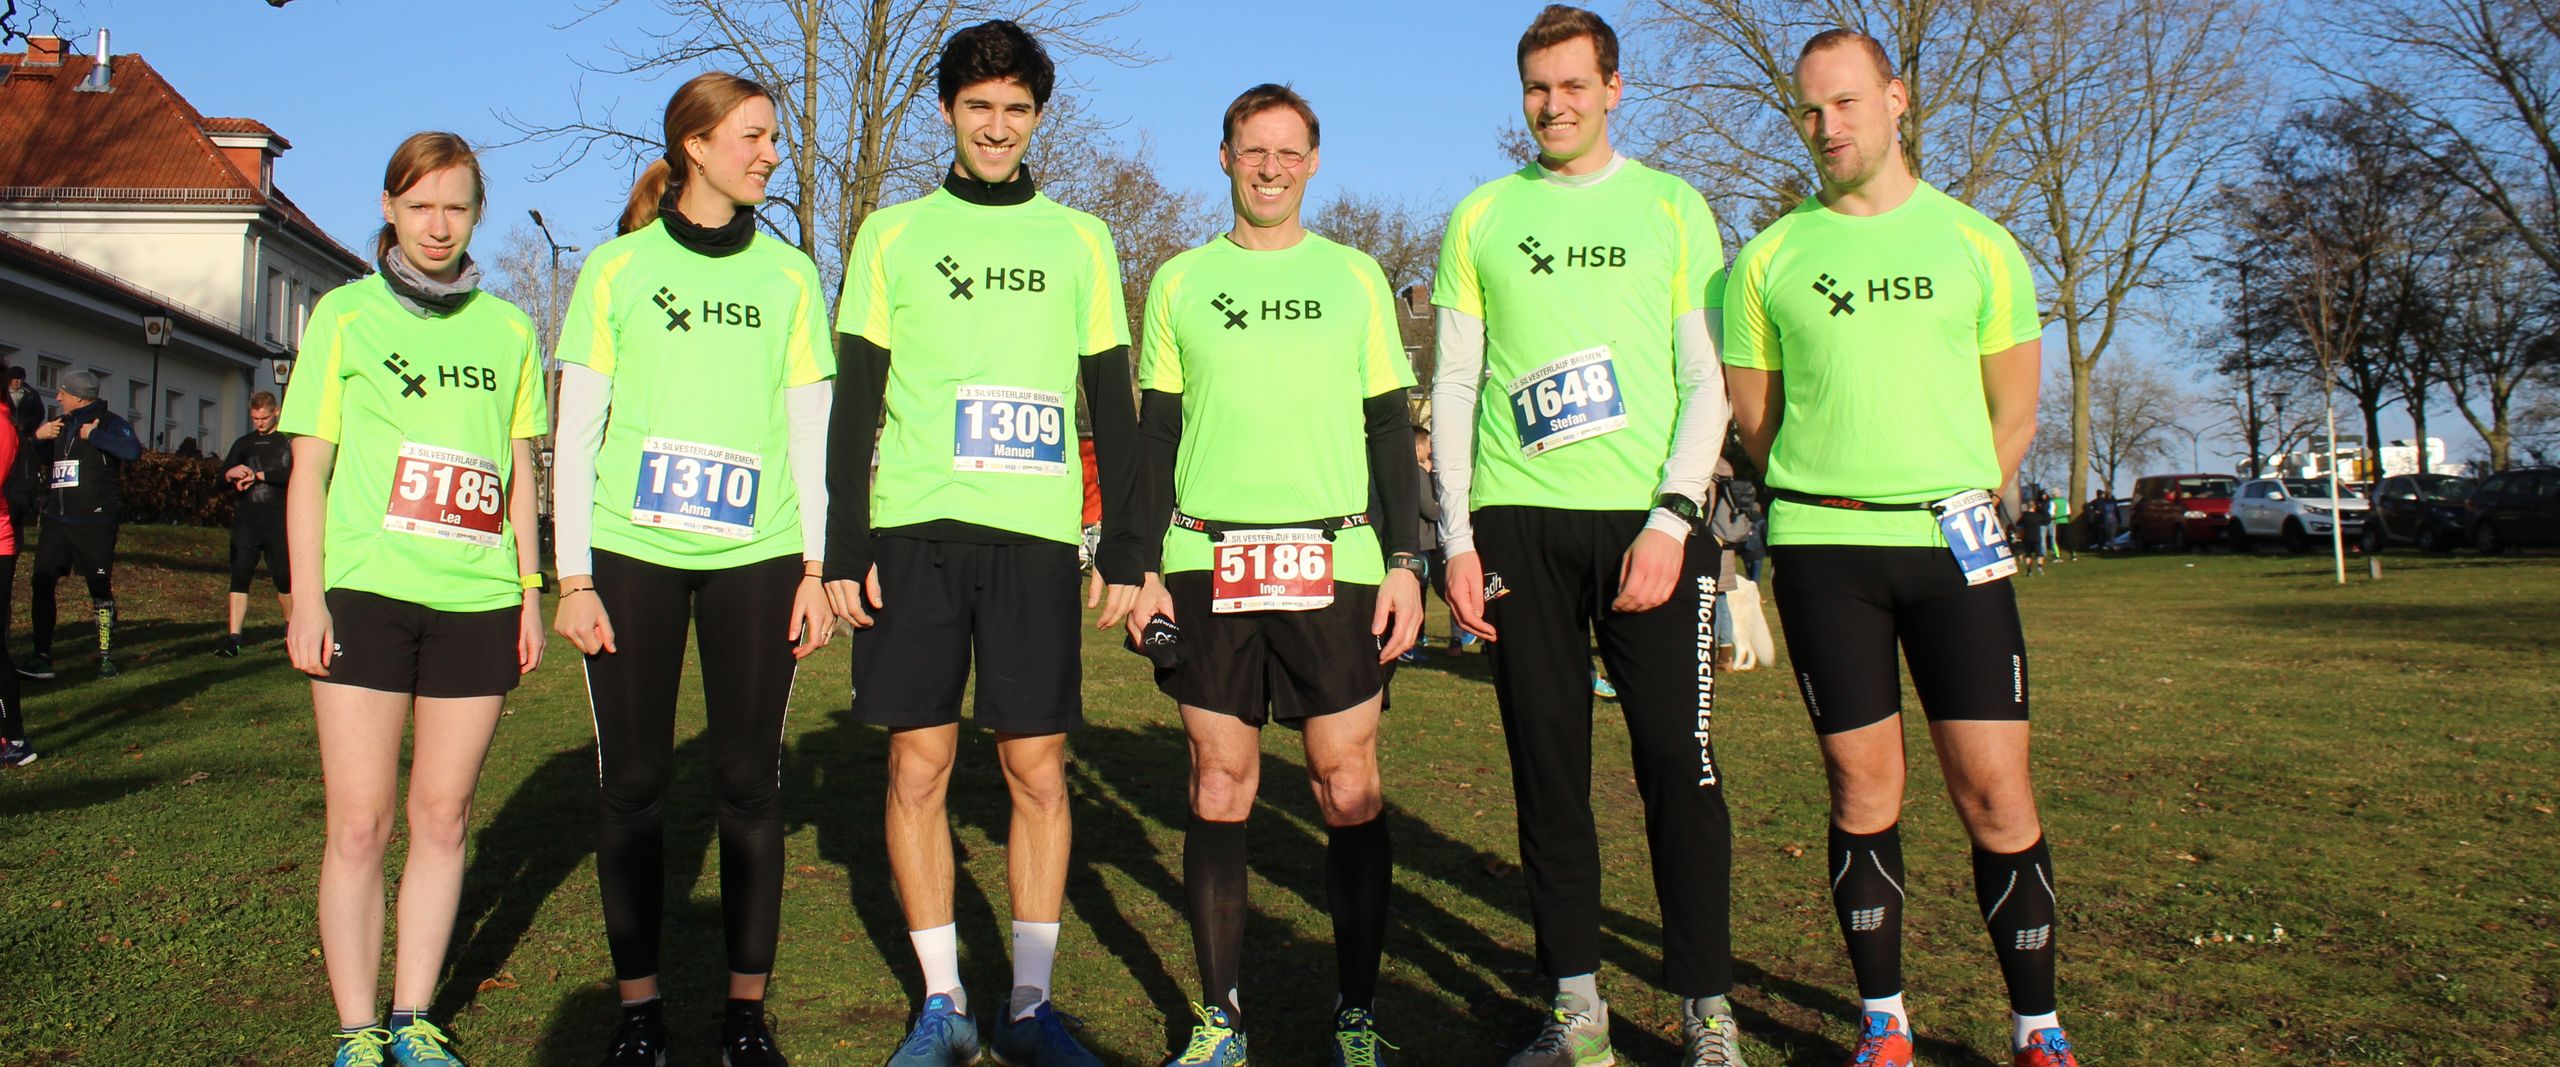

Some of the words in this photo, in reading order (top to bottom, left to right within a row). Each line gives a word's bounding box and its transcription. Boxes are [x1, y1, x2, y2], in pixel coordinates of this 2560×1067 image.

[1567, 246, 1626, 268] HSB
[985, 266, 1046, 293] HSB
[1866, 276, 1934, 303] HSB
[703, 300, 762, 329] HSB
[1261, 299, 1323, 321] HSB
[438, 365, 497, 392] HSB
[1520, 359, 1568, 386] SILVESTERLAUF
[1570, 351, 1602, 366] BREMEN
[966, 389, 973, 398] 3.
[975, 388, 1033, 400] SILVESTERLAUF
[1033, 393, 1060, 404] BREMEN
[1517, 364, 1614, 427] 1648
[964, 401, 1061, 446] 1309
[1549, 412, 1588, 432] Stefan
[408, 447, 417, 456] 3.
[417, 448, 479, 468] SILVESTERLAUF
[652, 441, 661, 450] 3.
[662, 442, 725, 459] SILVESTERLAUF
[724, 451, 755, 465] BREMEN
[994, 443, 1036, 459] Manuel
[399, 459, 500, 516] 5185
[649, 454, 754, 508] 1310
[440, 509, 462, 525] Lea
[679, 500, 712, 518] Anna
[1231, 532, 1290, 543] SILVESTERLAUF
[1292, 532, 1323, 542] BREMEN
[1950, 503, 2007, 552] 12
[1220, 544, 1326, 583] 5186
[1259, 582, 1286, 596] Ingo
[1484, 574, 1502, 600] adh
[1694, 575, 1717, 787] #hochschulsport
[1852, 921, 1882, 931] cep
[2015, 940, 2048, 950] cep
